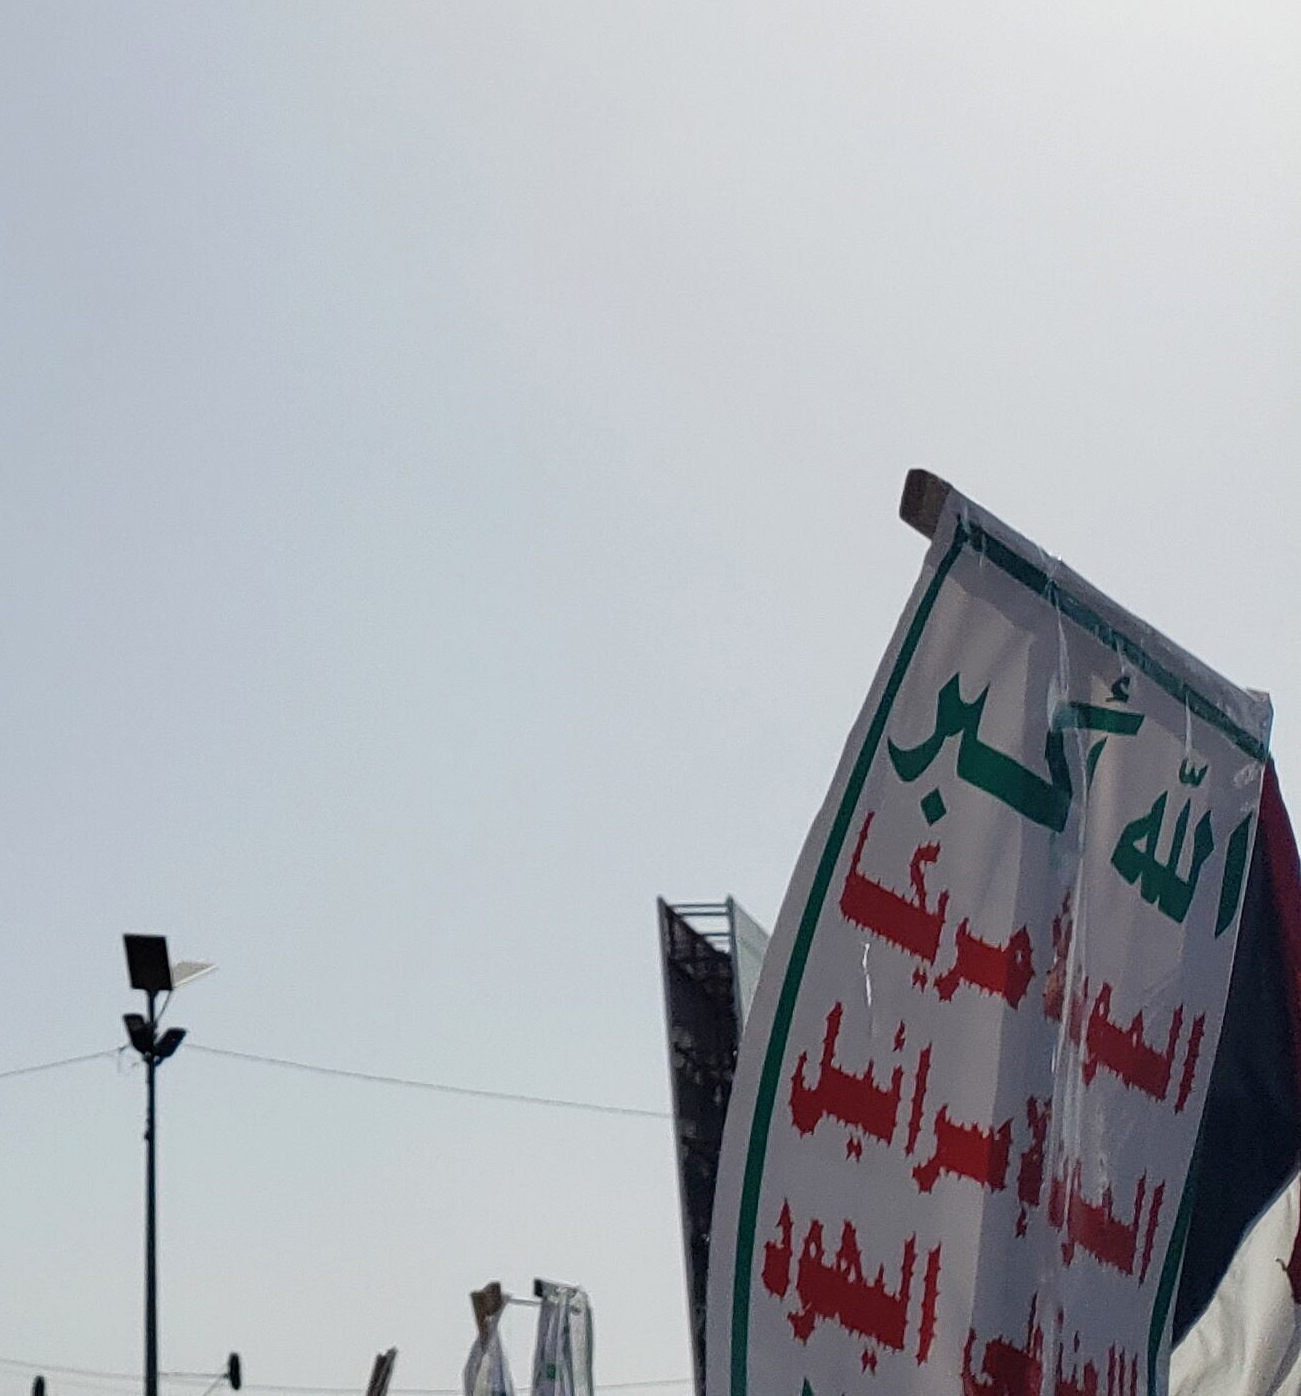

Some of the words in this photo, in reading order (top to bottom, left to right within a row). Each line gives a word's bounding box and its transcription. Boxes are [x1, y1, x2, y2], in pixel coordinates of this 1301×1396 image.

[886, 672, 1145, 834] أكبر
[1111, 759, 1253, 939] الله
[761, 1197, 943, 1375] اليهود
